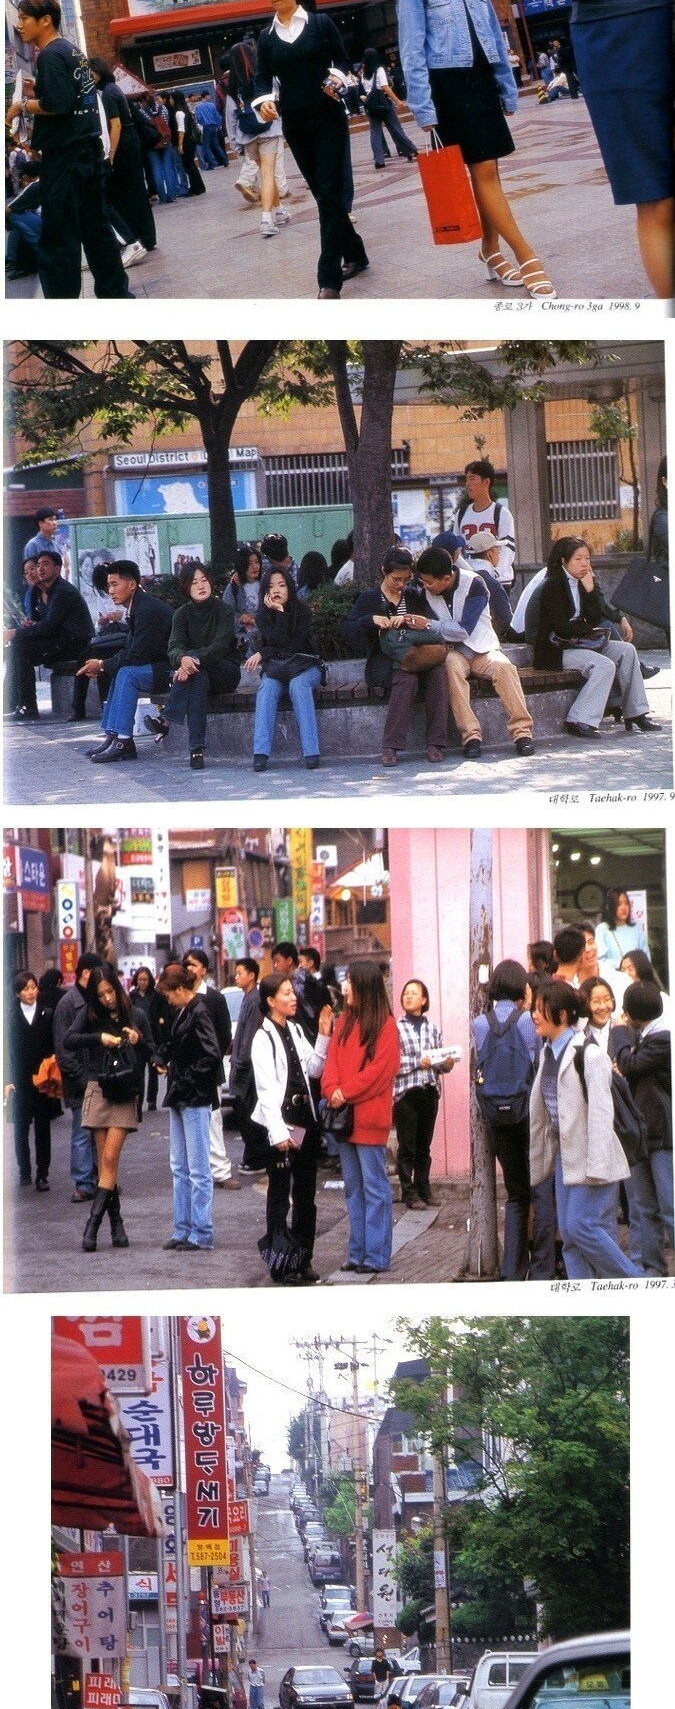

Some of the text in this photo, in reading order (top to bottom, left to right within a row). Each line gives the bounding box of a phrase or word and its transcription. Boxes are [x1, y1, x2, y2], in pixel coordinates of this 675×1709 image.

[115, 446, 258, 467] Seoul District Map
[122, 1400, 167, 1471] 순대국
[71, 1582, 92, 1653] 장어구이
[96, 1581, 118, 1651] 추어탕
[220, 1589, 246, 1604] 부동산
